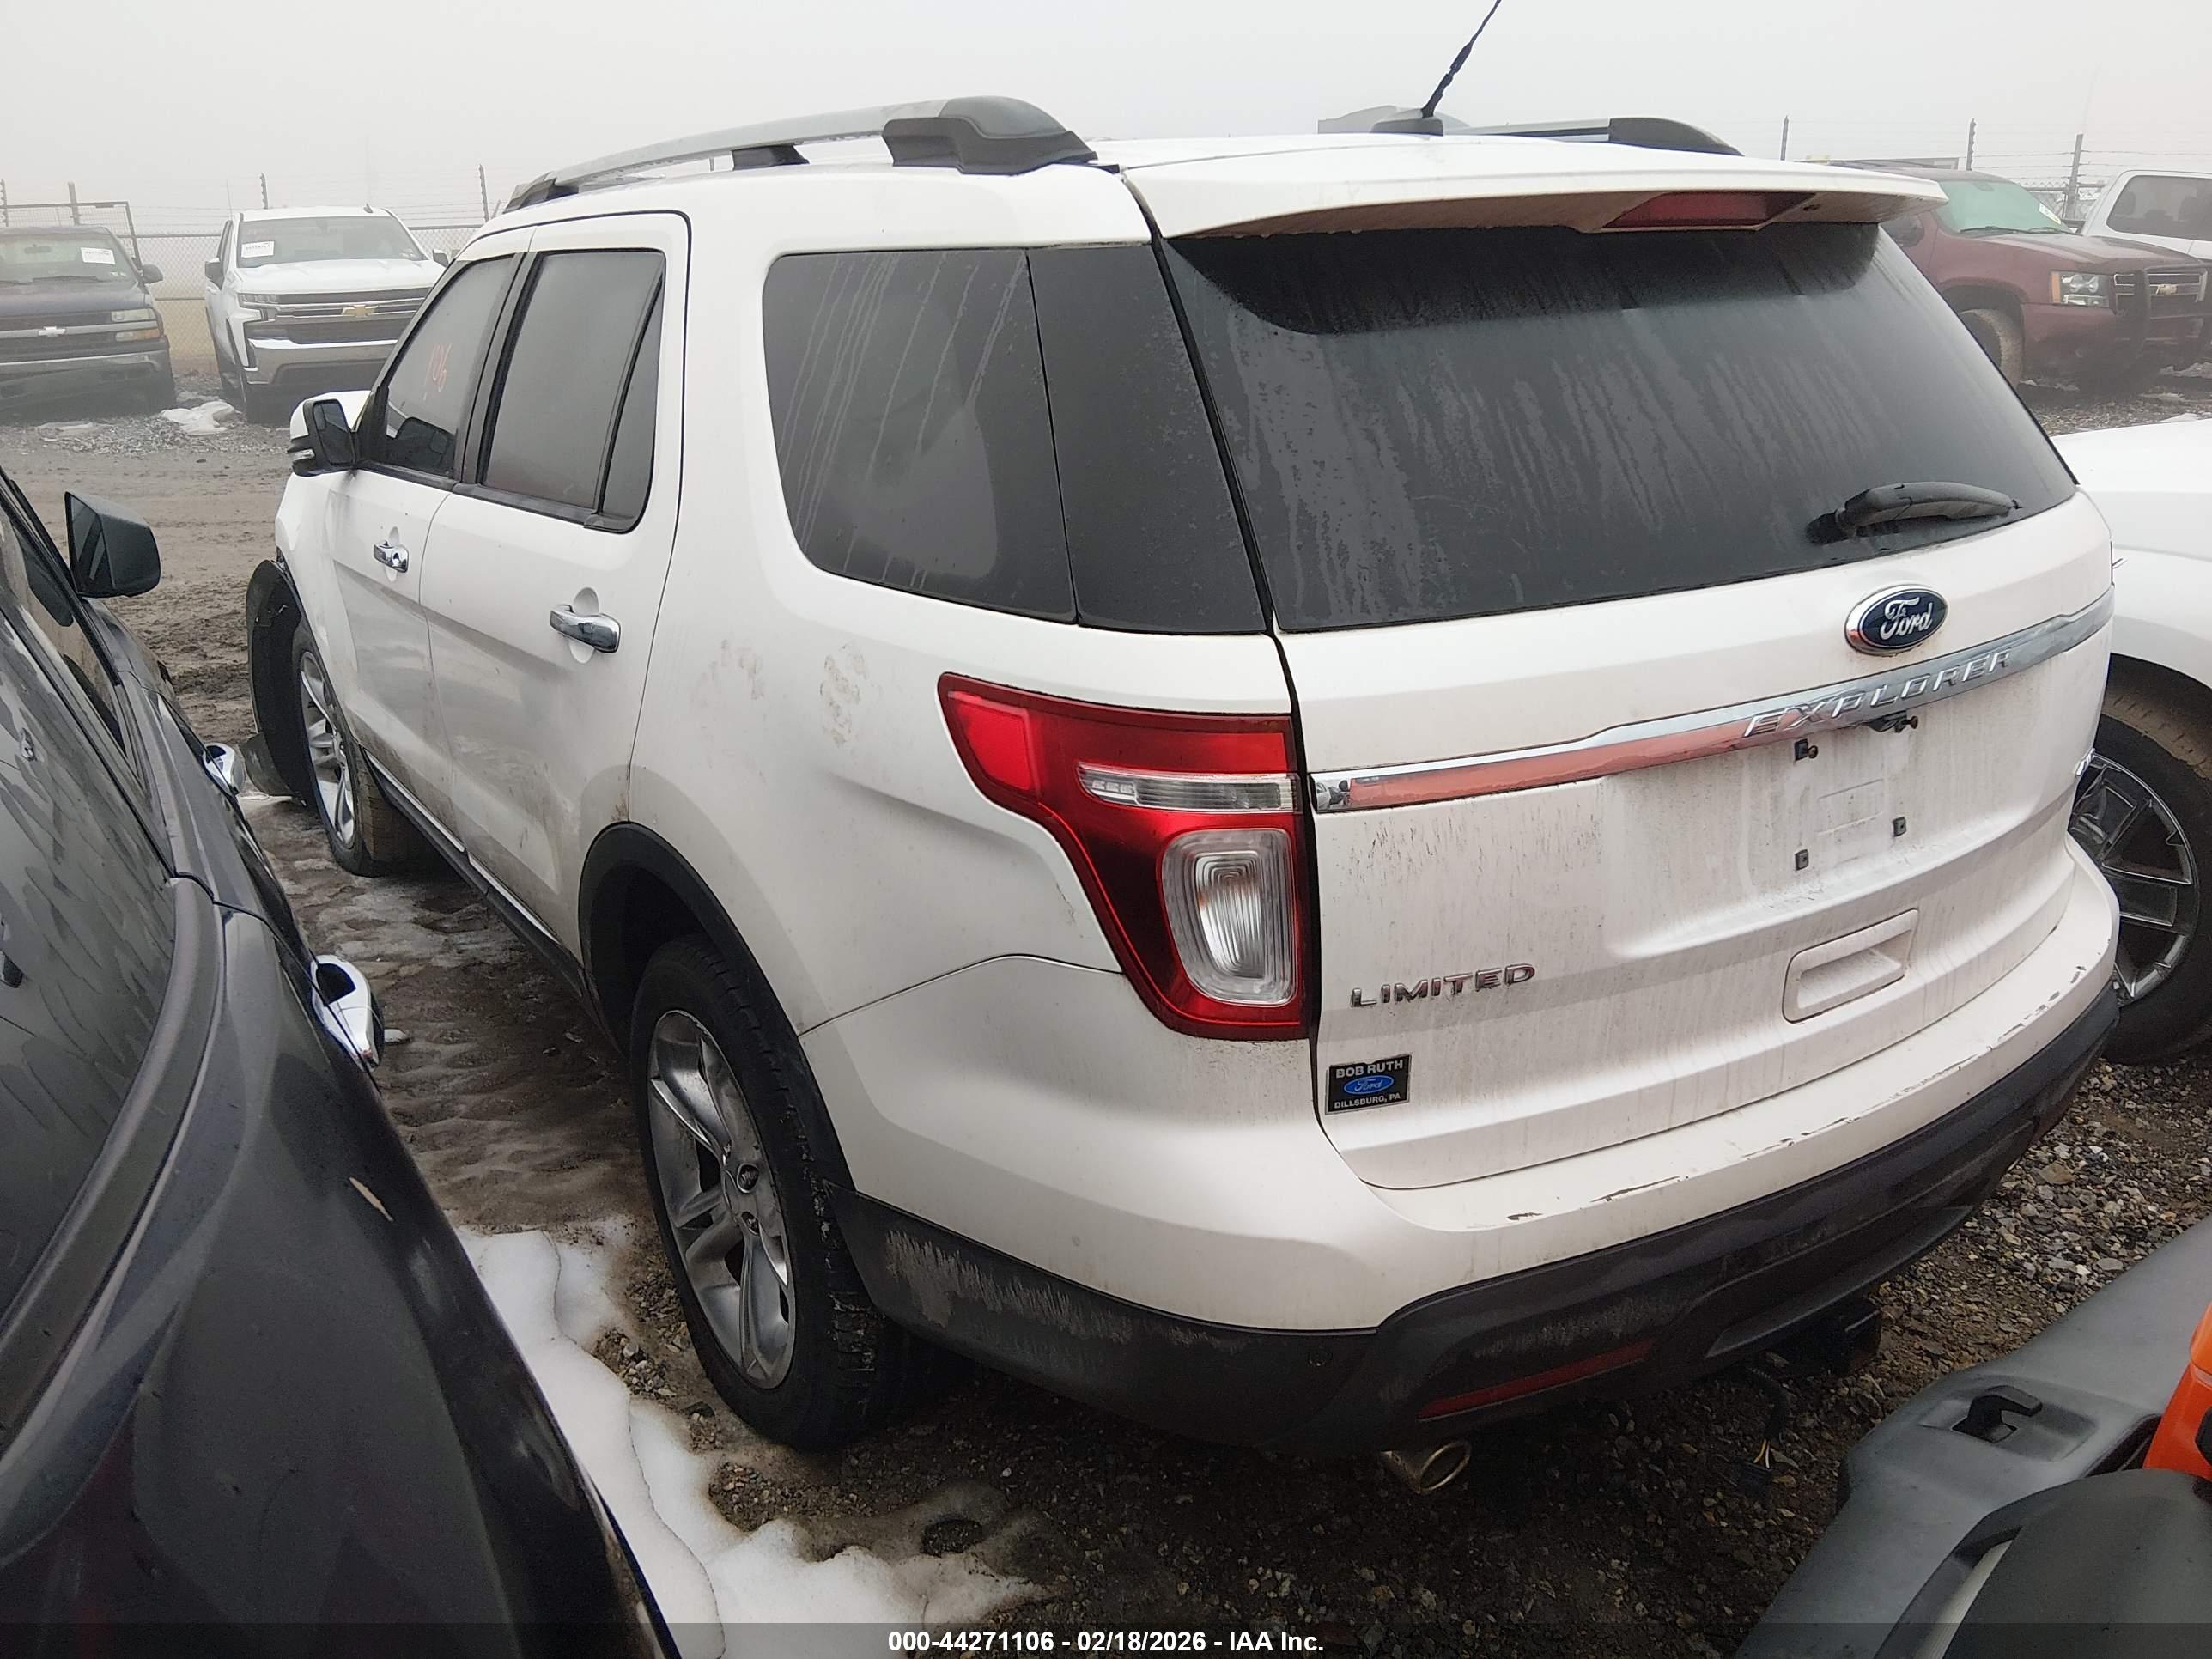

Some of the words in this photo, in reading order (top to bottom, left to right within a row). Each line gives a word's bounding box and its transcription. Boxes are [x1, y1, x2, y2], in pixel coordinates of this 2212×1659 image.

[1880, 597, 1933, 640] Ford
[1743, 648, 2012, 738] EXPLORER
[1350, 963, 1535, 1007] LIMITED
[1335, 1066, 1364, 1079] BOB
[1367, 1060, 1403, 1074] RUTH
[1354, 1079, 1383, 1091] Ford
[1334, 1095, 1388, 1109] DILLSBURG,
[1389, 1092, 1401, 1101] PA
